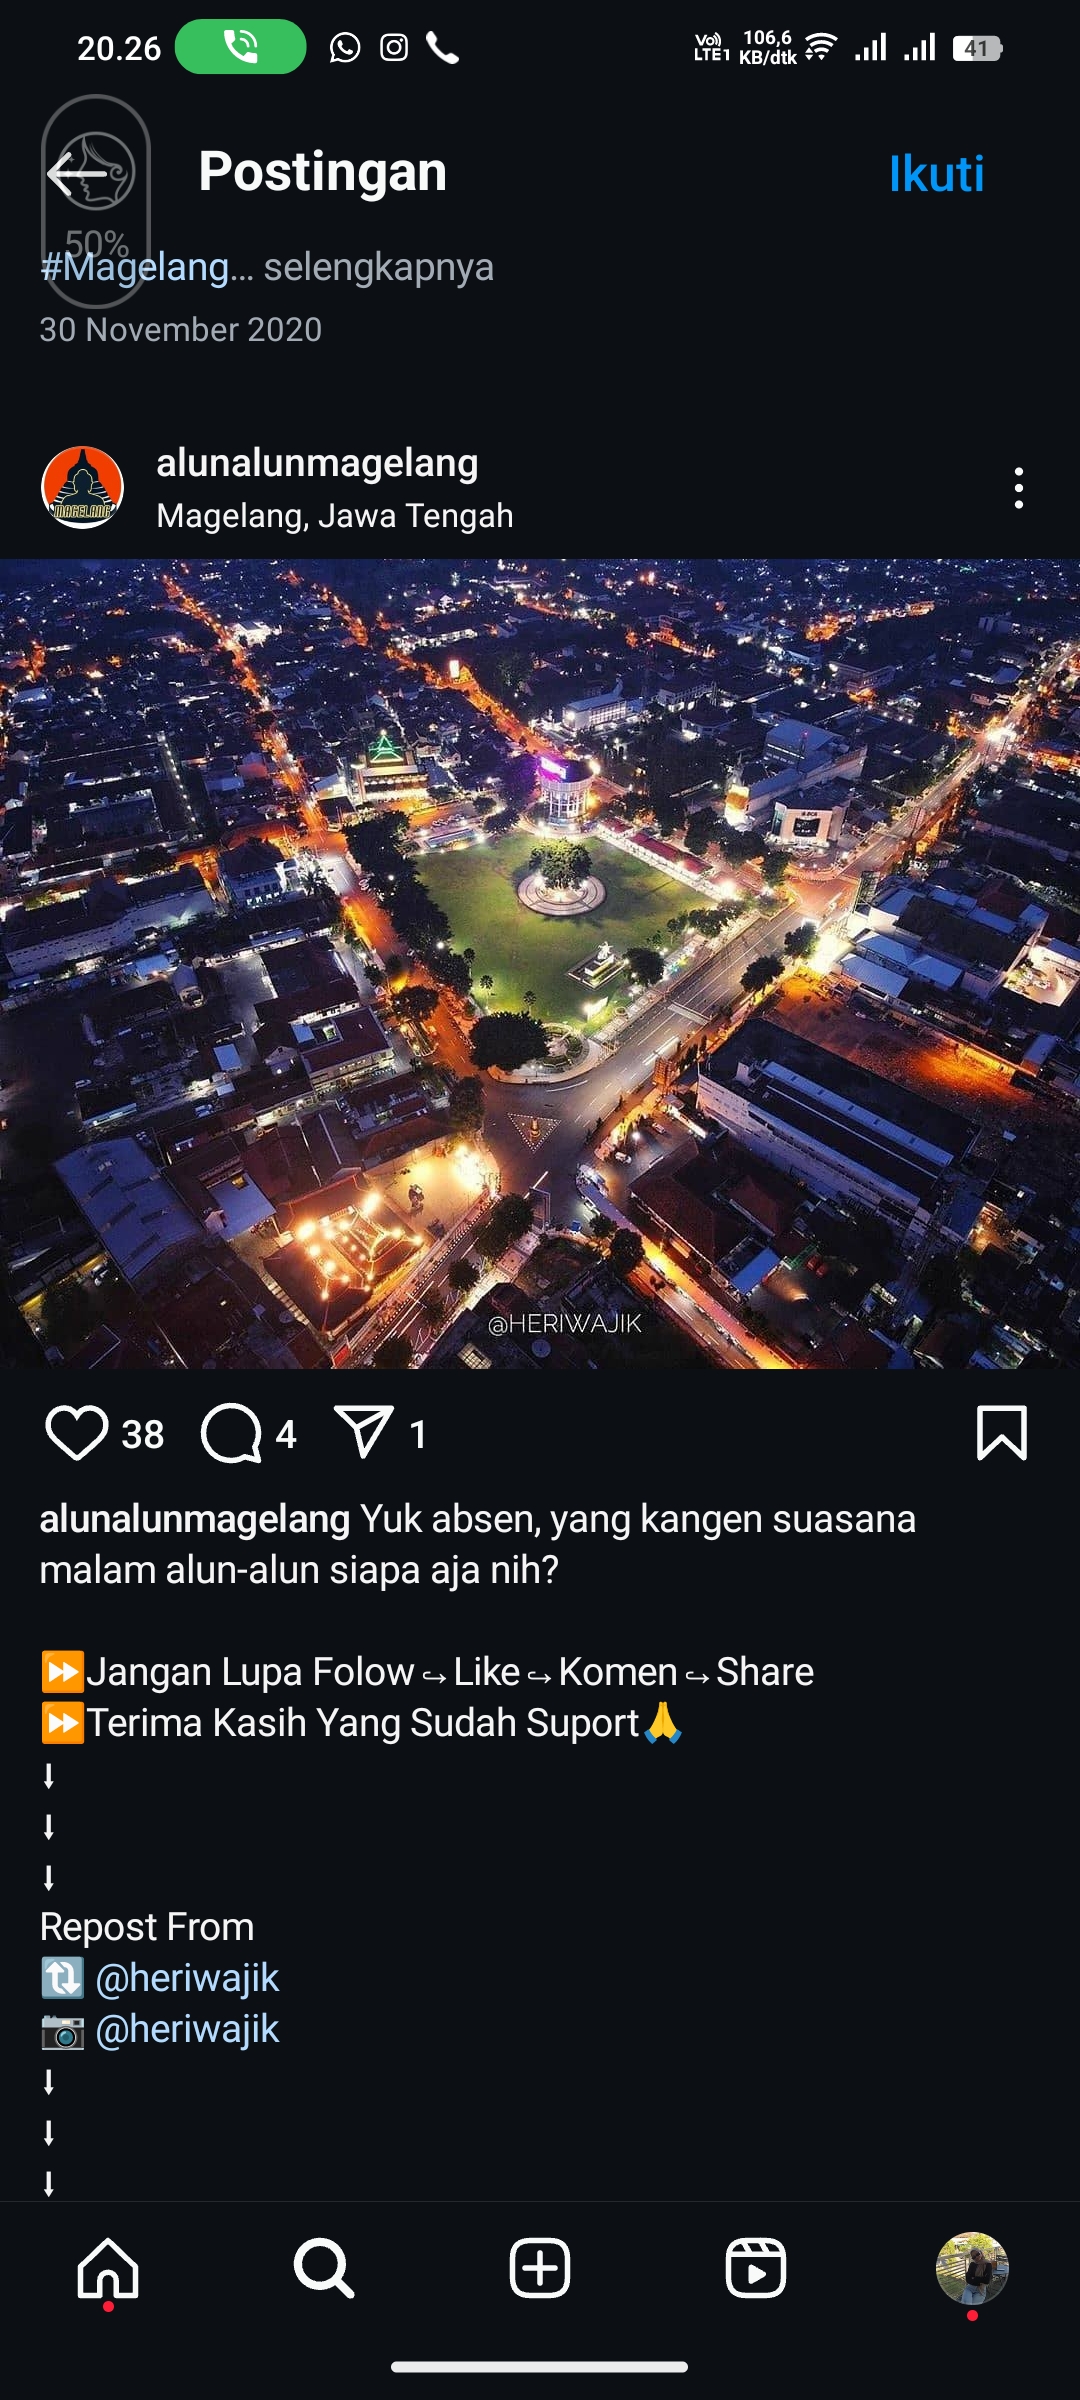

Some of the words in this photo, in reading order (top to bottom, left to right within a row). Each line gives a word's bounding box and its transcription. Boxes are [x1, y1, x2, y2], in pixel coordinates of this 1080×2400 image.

[77, 36, 162, 62] 20.26
[743, 29, 793, 47] 106,6
[965, 39, 988, 57] 41
[739, 48, 798, 67] KB/dtk
[200, 148, 446, 203] Postingan
[891, 152, 984, 193] Ikuti
[65, 229, 130, 258] 50%
[264, 249, 494, 290] selengkapnya
[39, 316, 76, 343] 30
[86, 315, 240, 343] November
[247, 316, 322, 343] 2020
[156, 445, 478, 486] alunalunmagelang
[54, 504, 111, 518] MAGELANG
[157, 502, 309, 535] Magelang,
[318, 502, 396, 529] Jawa
[404, 502, 513, 535] Tengah
[121, 1419, 165, 1450] 38
[275, 1419, 298, 1449] 4
[410, 1419, 424, 1449] 1
[39, 1501, 350, 1542] alunalunmagelang
[359, 1501, 424, 1534] Yuk
[432, 1501, 541, 1539] absen,
[549, 1510, 631, 1542] yang
[641, 1501, 762, 1542] kangen
[772, 1510, 916, 1534] suasana
[40, 1552, 156, 1585] malam
[166, 1552, 319, 1585] alun-alun
[329, 1554, 420, 1592] siapa
[431, 1554, 480, 1593] aja
[491, 1552, 559, 1585] nih?
[86, 1656, 211, 1695] Jangan
[223, 1656, 302, 1694] Lupa
[314, 1654, 416, 1687] Folow
[455, 1654, 521, 1687] Like
[560, 1656, 677, 1687] Komen
[716, 1654, 815, 1687] Share
[86, 1706, 202, 1738] Terima
[214, 1705, 306, 1738] Kasih
[315, 1707, 401, 1746] Yang
[410, 1705, 516, 1738] Sudah
[526, 1707, 640, 1745] Suport
[41, 1911, 158, 1949] Repost
[168, 1911, 254, 1942] From
[96, 1960, 281, 2001] @heriwajik
[96, 2011, 281, 2052] @heriwajik
